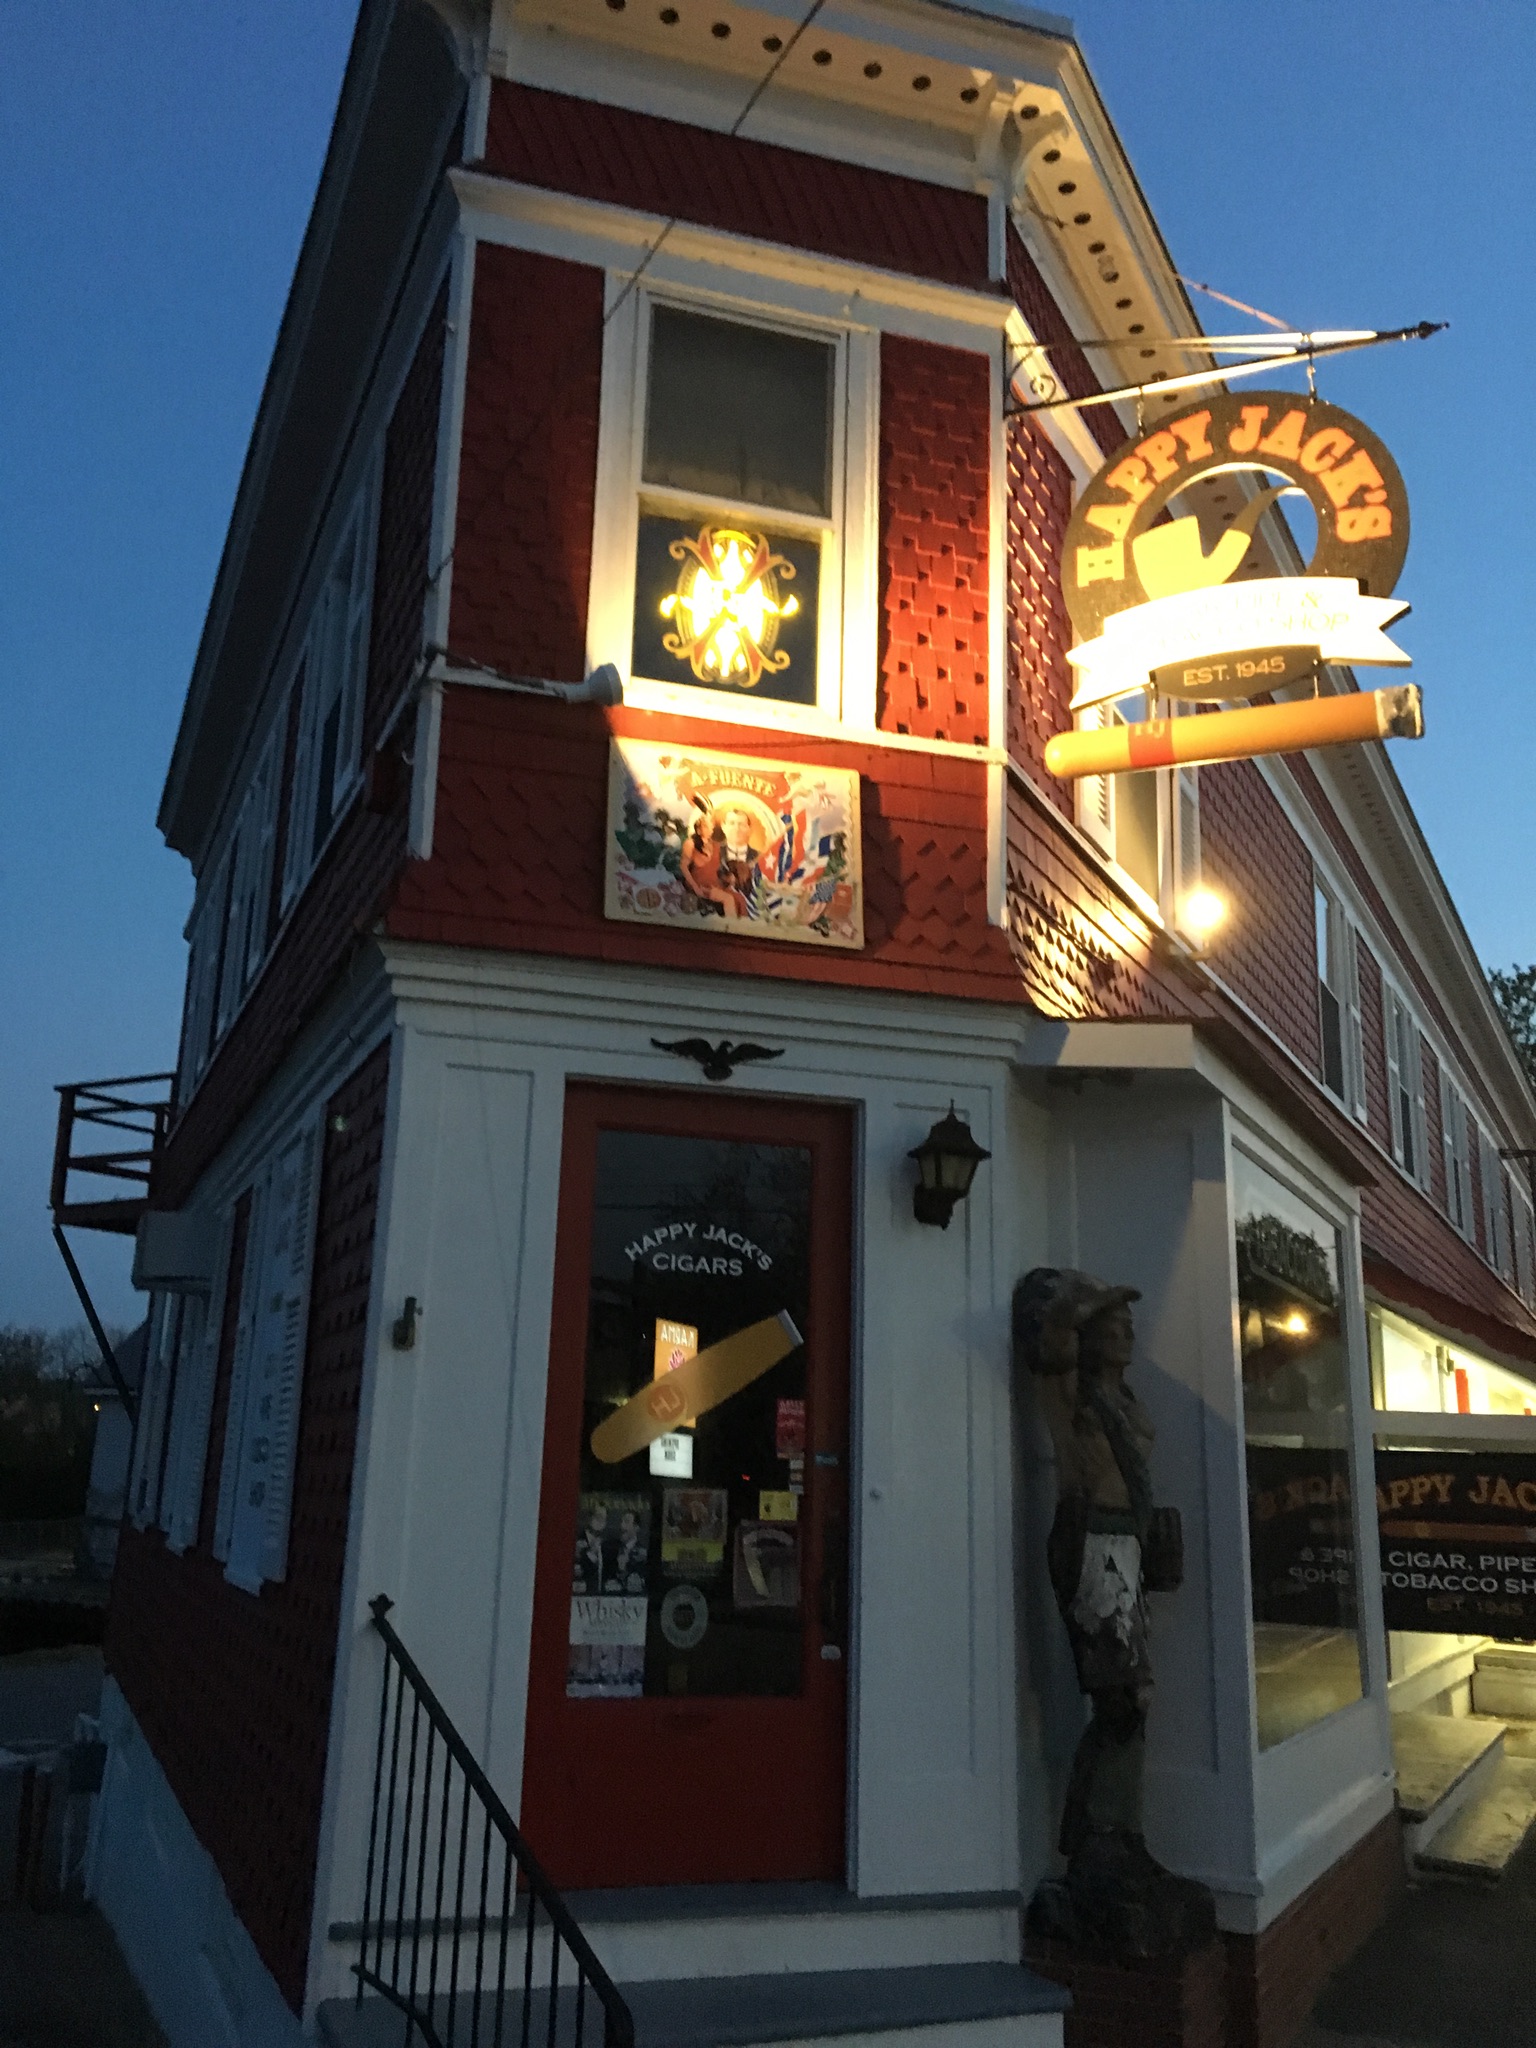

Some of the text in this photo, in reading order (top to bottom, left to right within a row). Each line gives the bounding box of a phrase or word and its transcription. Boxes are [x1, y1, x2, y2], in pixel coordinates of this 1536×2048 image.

[1076, 405, 1393, 588] HAPPY JACK'S
[1183, 656, 1286, 686] EST. 1945
[624, 1222, 773, 1271] HAPPY JACK'S
[652, 1252, 743, 1277] CIGARS
[1388, 1550, 1473, 1572] CIGAR,
